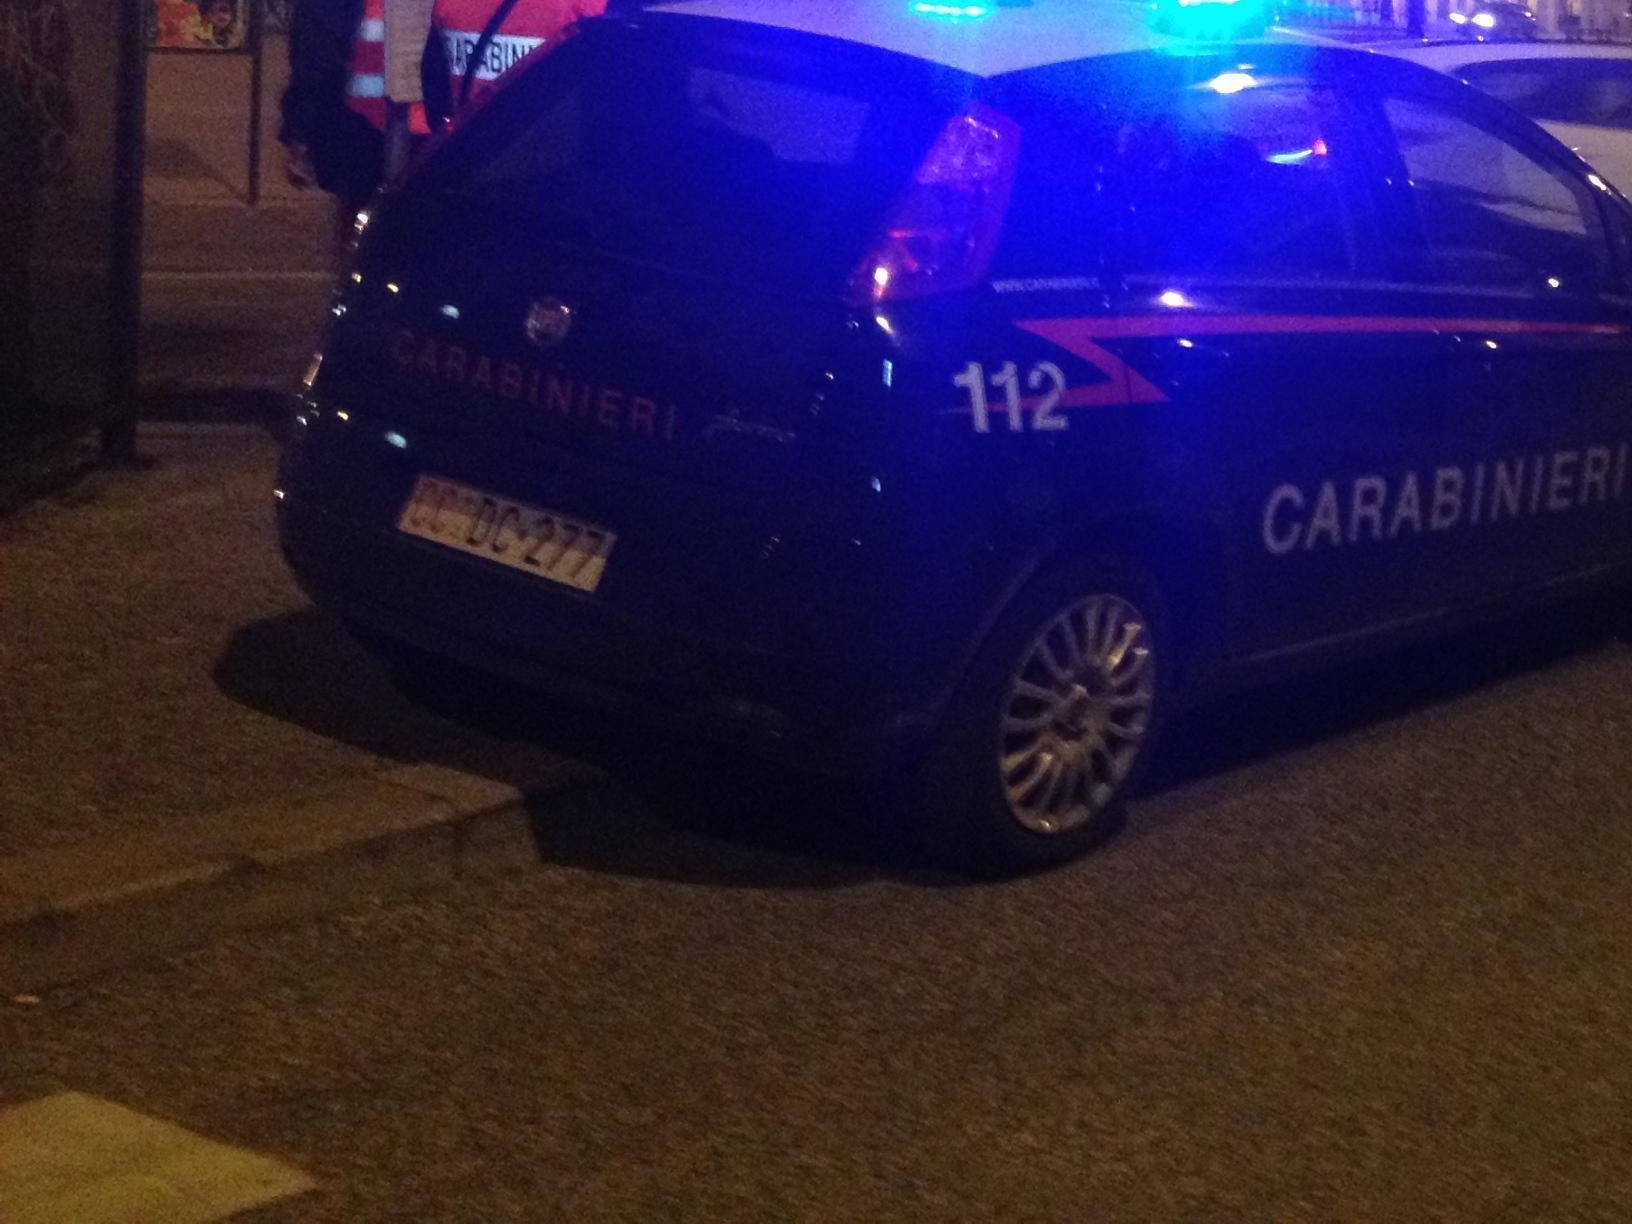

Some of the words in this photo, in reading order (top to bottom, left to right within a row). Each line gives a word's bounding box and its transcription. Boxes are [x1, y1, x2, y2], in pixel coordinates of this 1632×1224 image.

[392, 330, 678, 440] CARABINIERI
[953, 360, 1069, 433] 112
[1262, 441, 1629, 554] CARABINIERI
